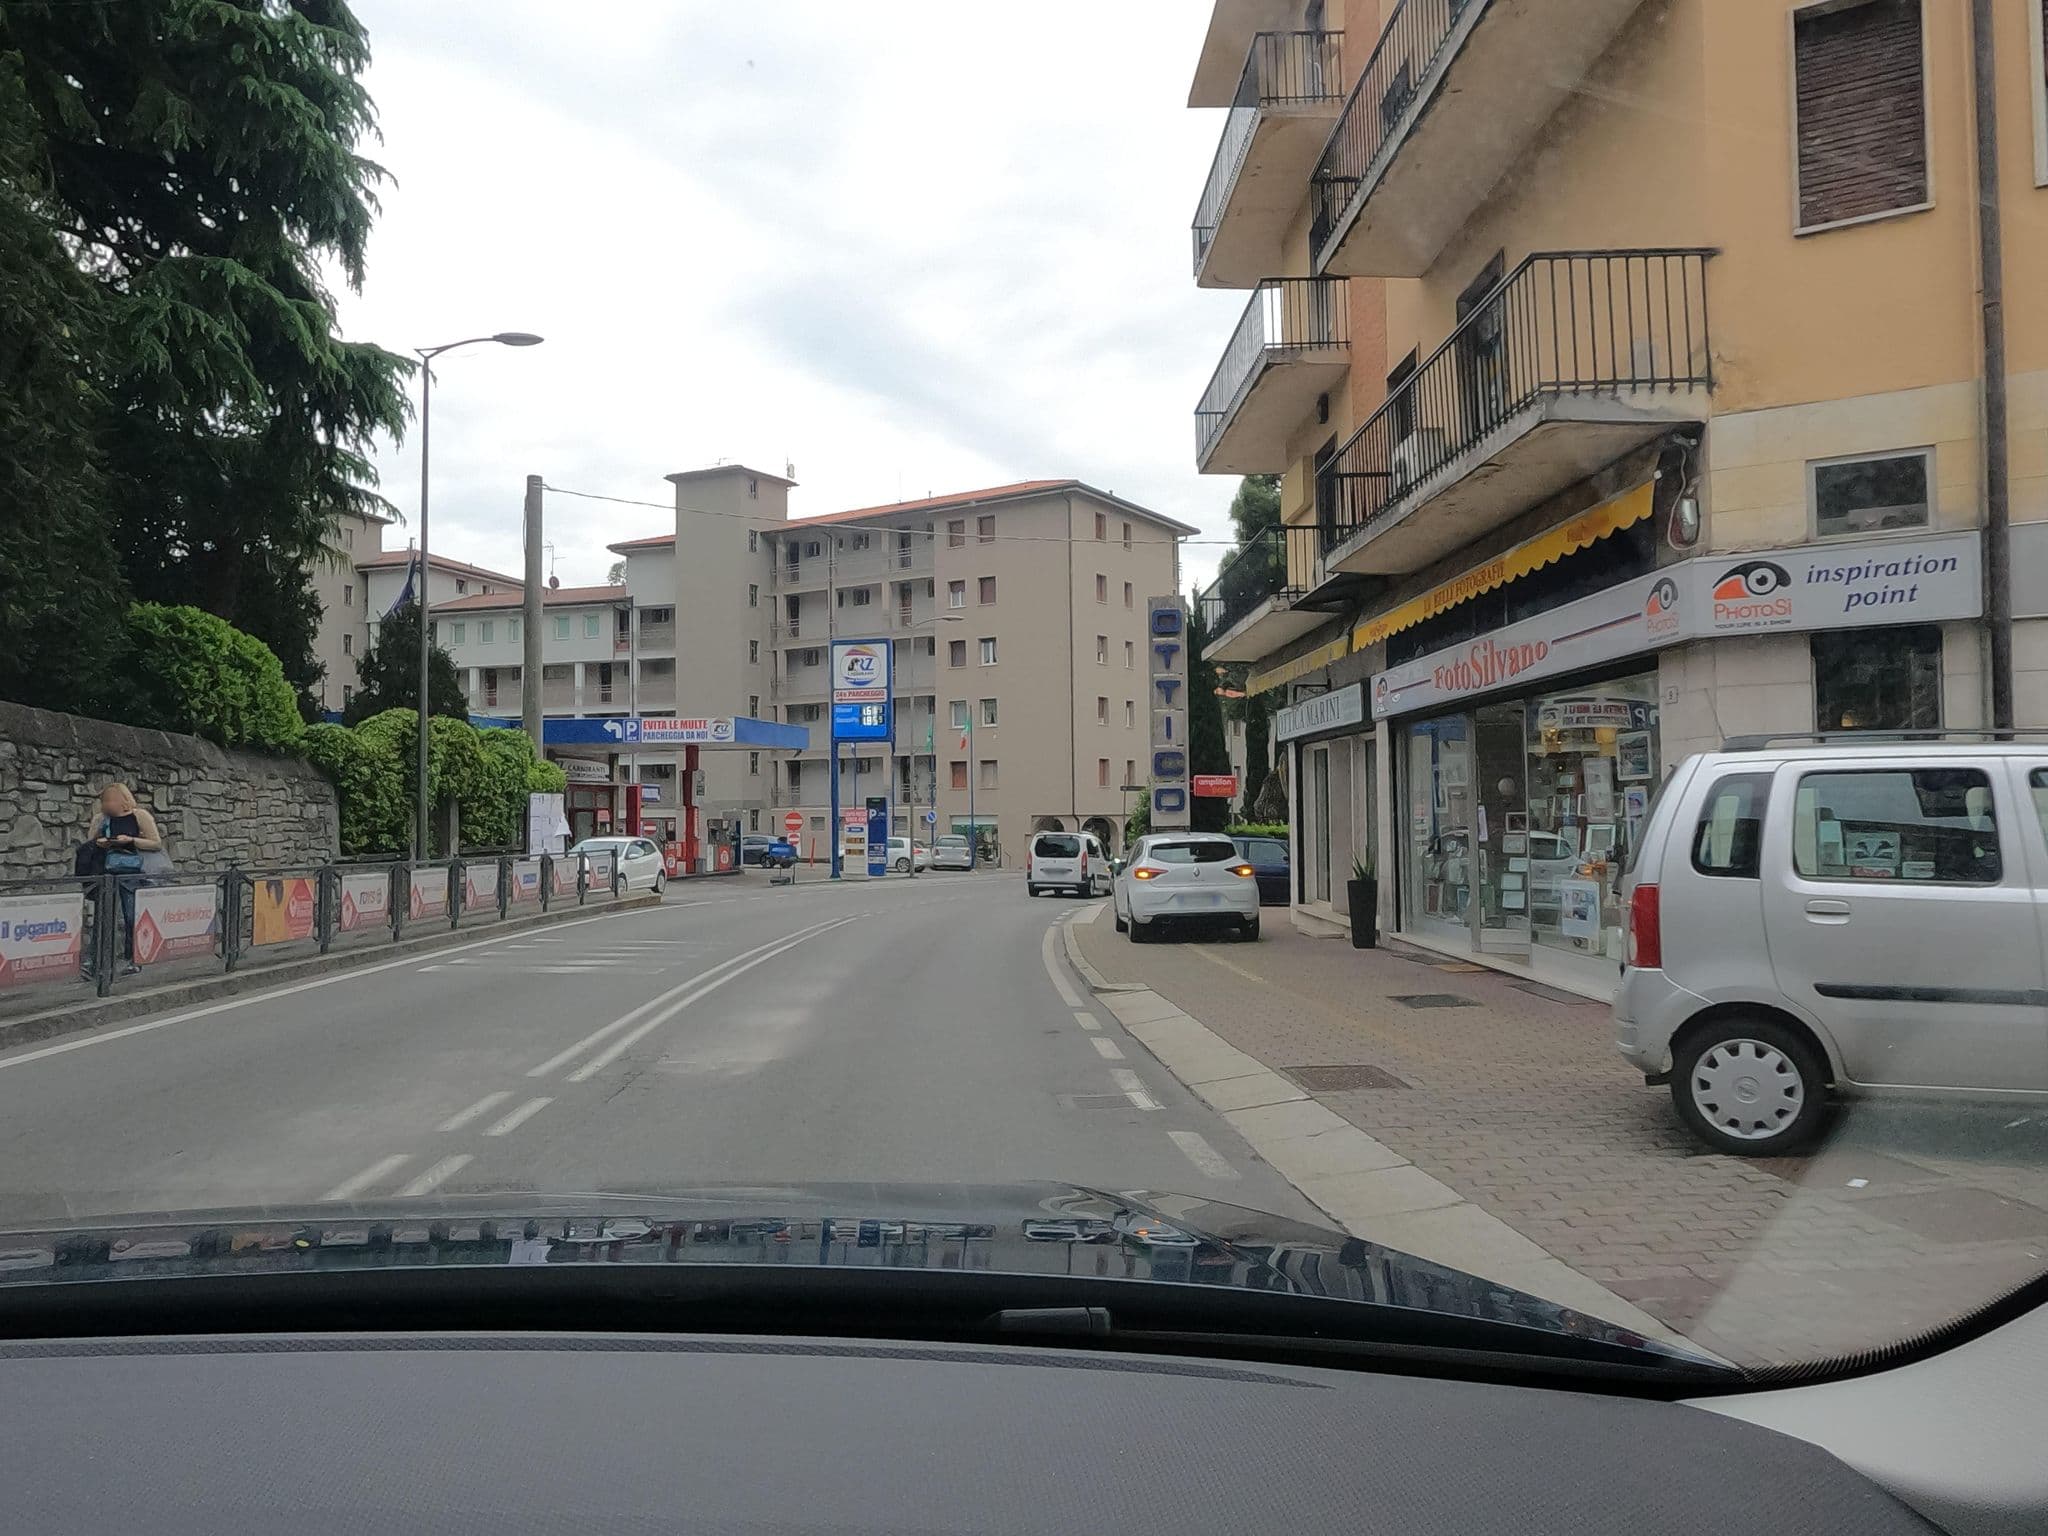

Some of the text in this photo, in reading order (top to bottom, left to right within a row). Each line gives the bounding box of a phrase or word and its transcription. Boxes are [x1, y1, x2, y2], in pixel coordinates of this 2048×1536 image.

[1806, 554, 1958, 586] inspiration
[1843, 583, 1919, 612] point
[1433, 640, 1549, 690] FotoSilvano
[1152, 608, 1185, 812] OTTICO
[1279, 696, 1340, 736] OTTICA MARINI
[626, 721, 638, 736] P
[643, 719, 708, 730] EVITA LE MULTE
[643, 730, 684, 740] PARCHEGGIA
[686, 730, 695, 740] DA
[696, 730, 709, 740] NOI
[1199, 778, 1232, 787] amplifon
[869, 808, 878, 820] P
[2, 918, 67, 941] il gigante
